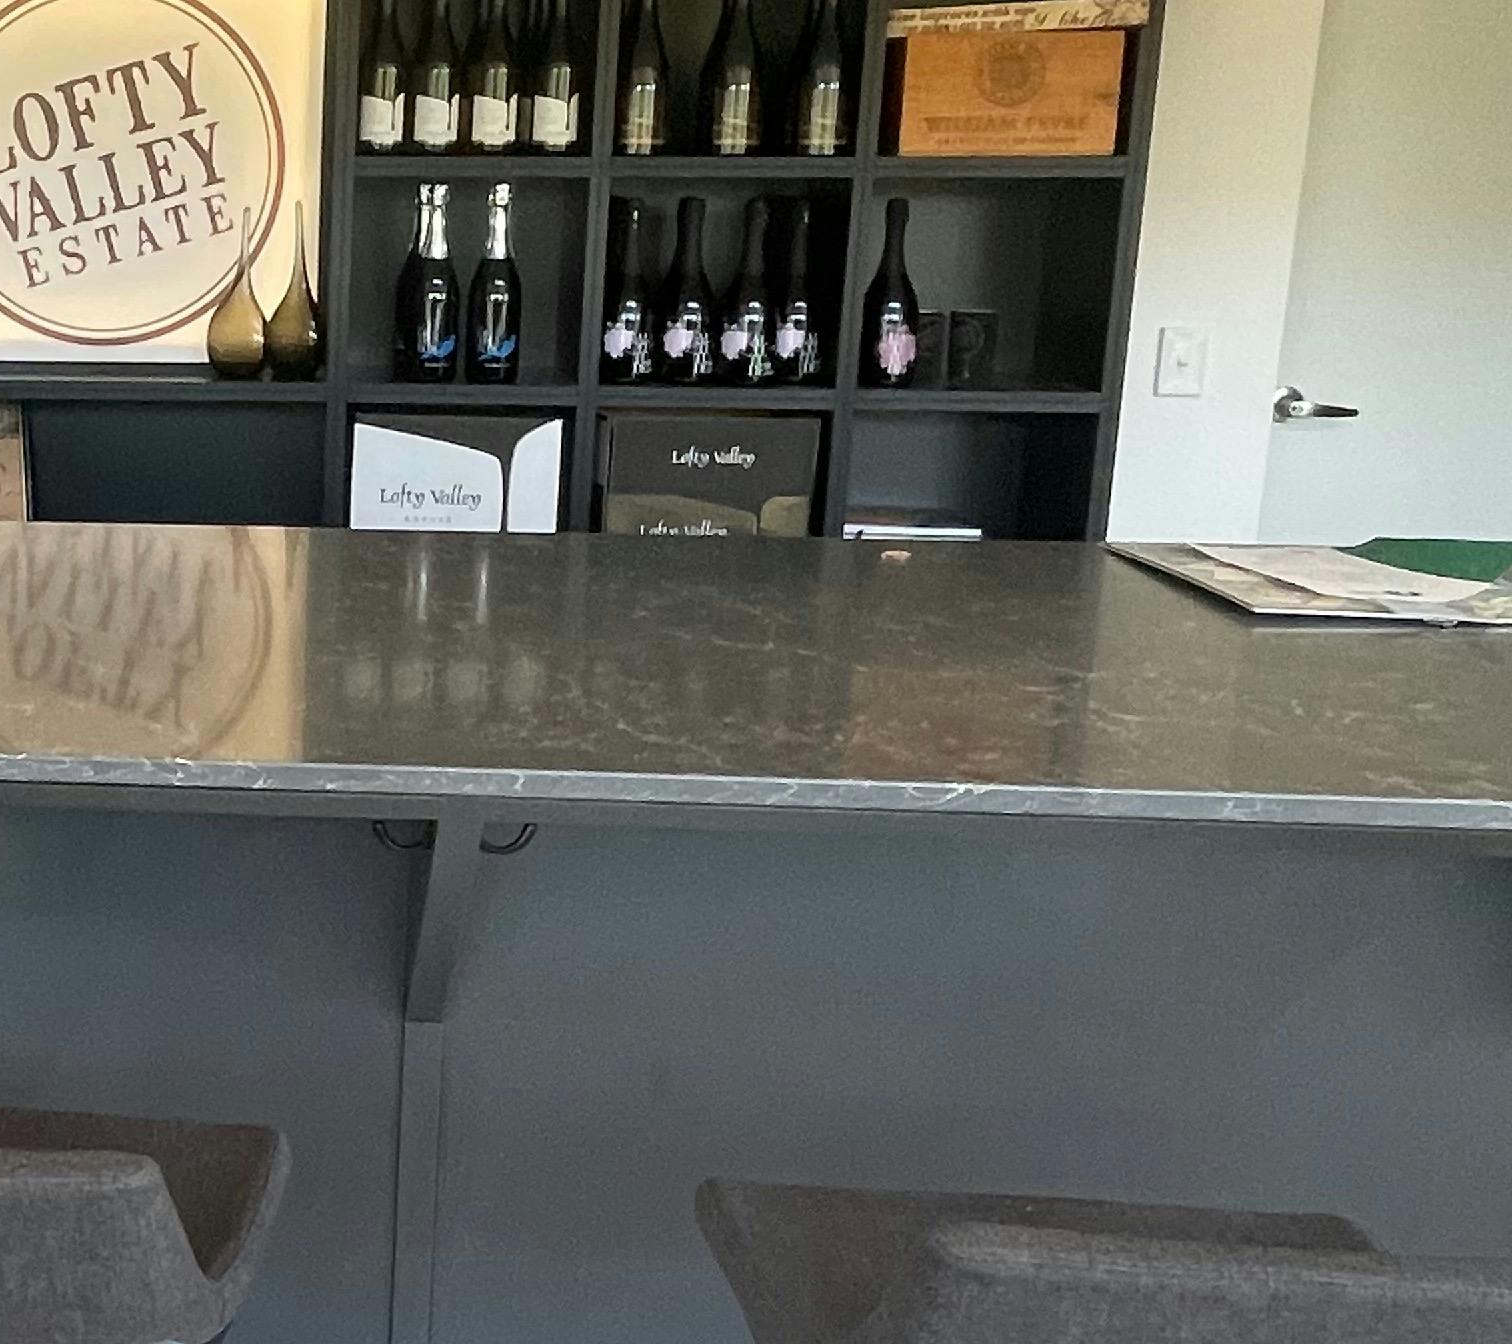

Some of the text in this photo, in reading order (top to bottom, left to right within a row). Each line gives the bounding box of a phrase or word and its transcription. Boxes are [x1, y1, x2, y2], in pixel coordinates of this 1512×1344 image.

[16, 192, 234, 289] ESTATE
[672, 445, 756, 470] Lofty Valley
[379, 482, 482, 511] Lofty Valley
